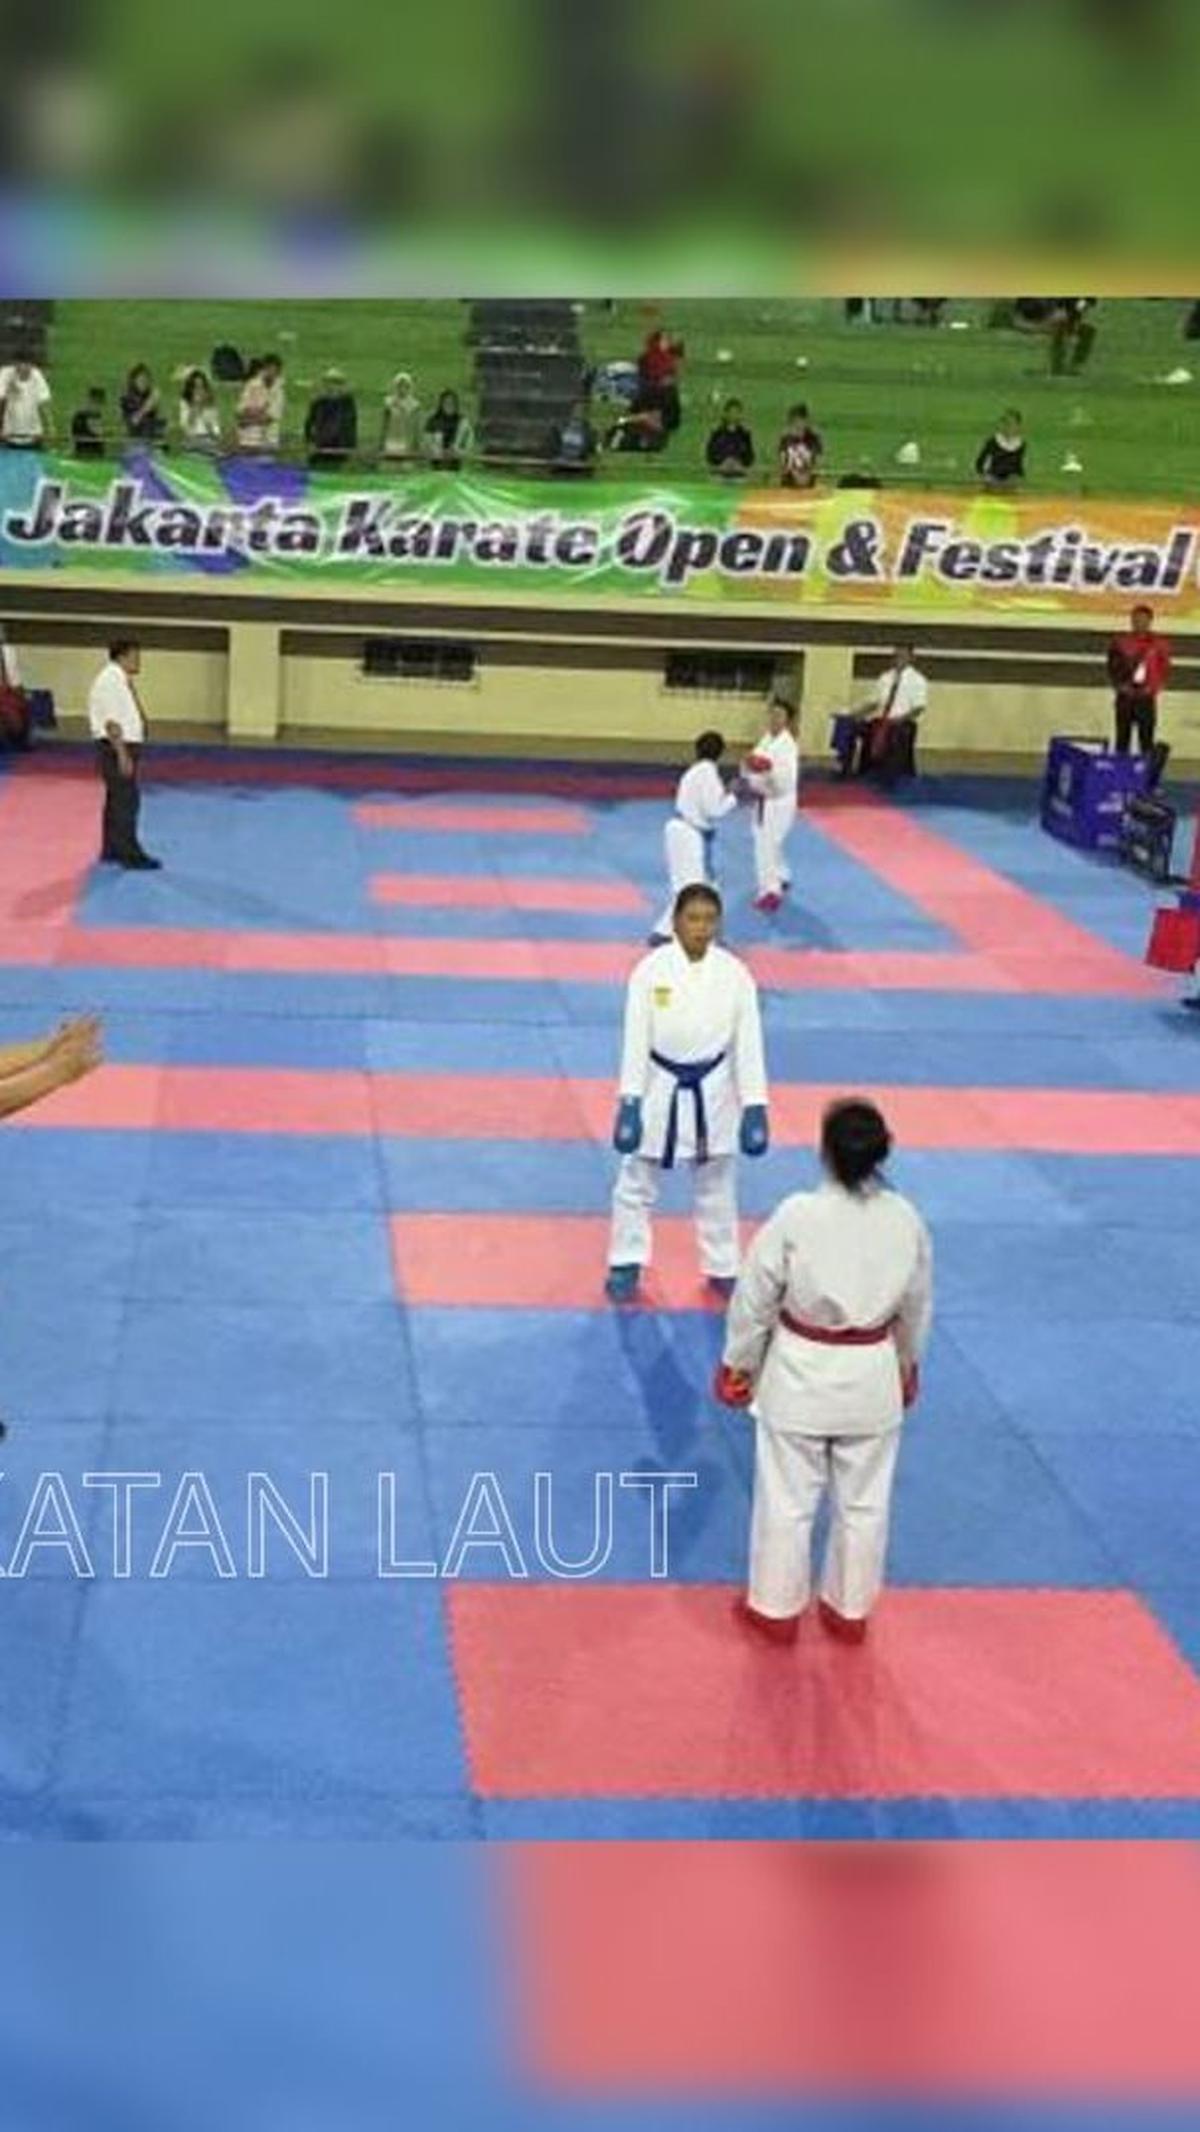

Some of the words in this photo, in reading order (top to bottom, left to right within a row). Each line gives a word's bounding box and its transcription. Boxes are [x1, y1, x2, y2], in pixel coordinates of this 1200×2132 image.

[5, 482, 322, 553] Jakarta
[338, 497, 597, 566] Karate
[616, 511, 810, 583] Open
[825, 519, 881, 579] &
[899, 521, 1192, 591] Festival
